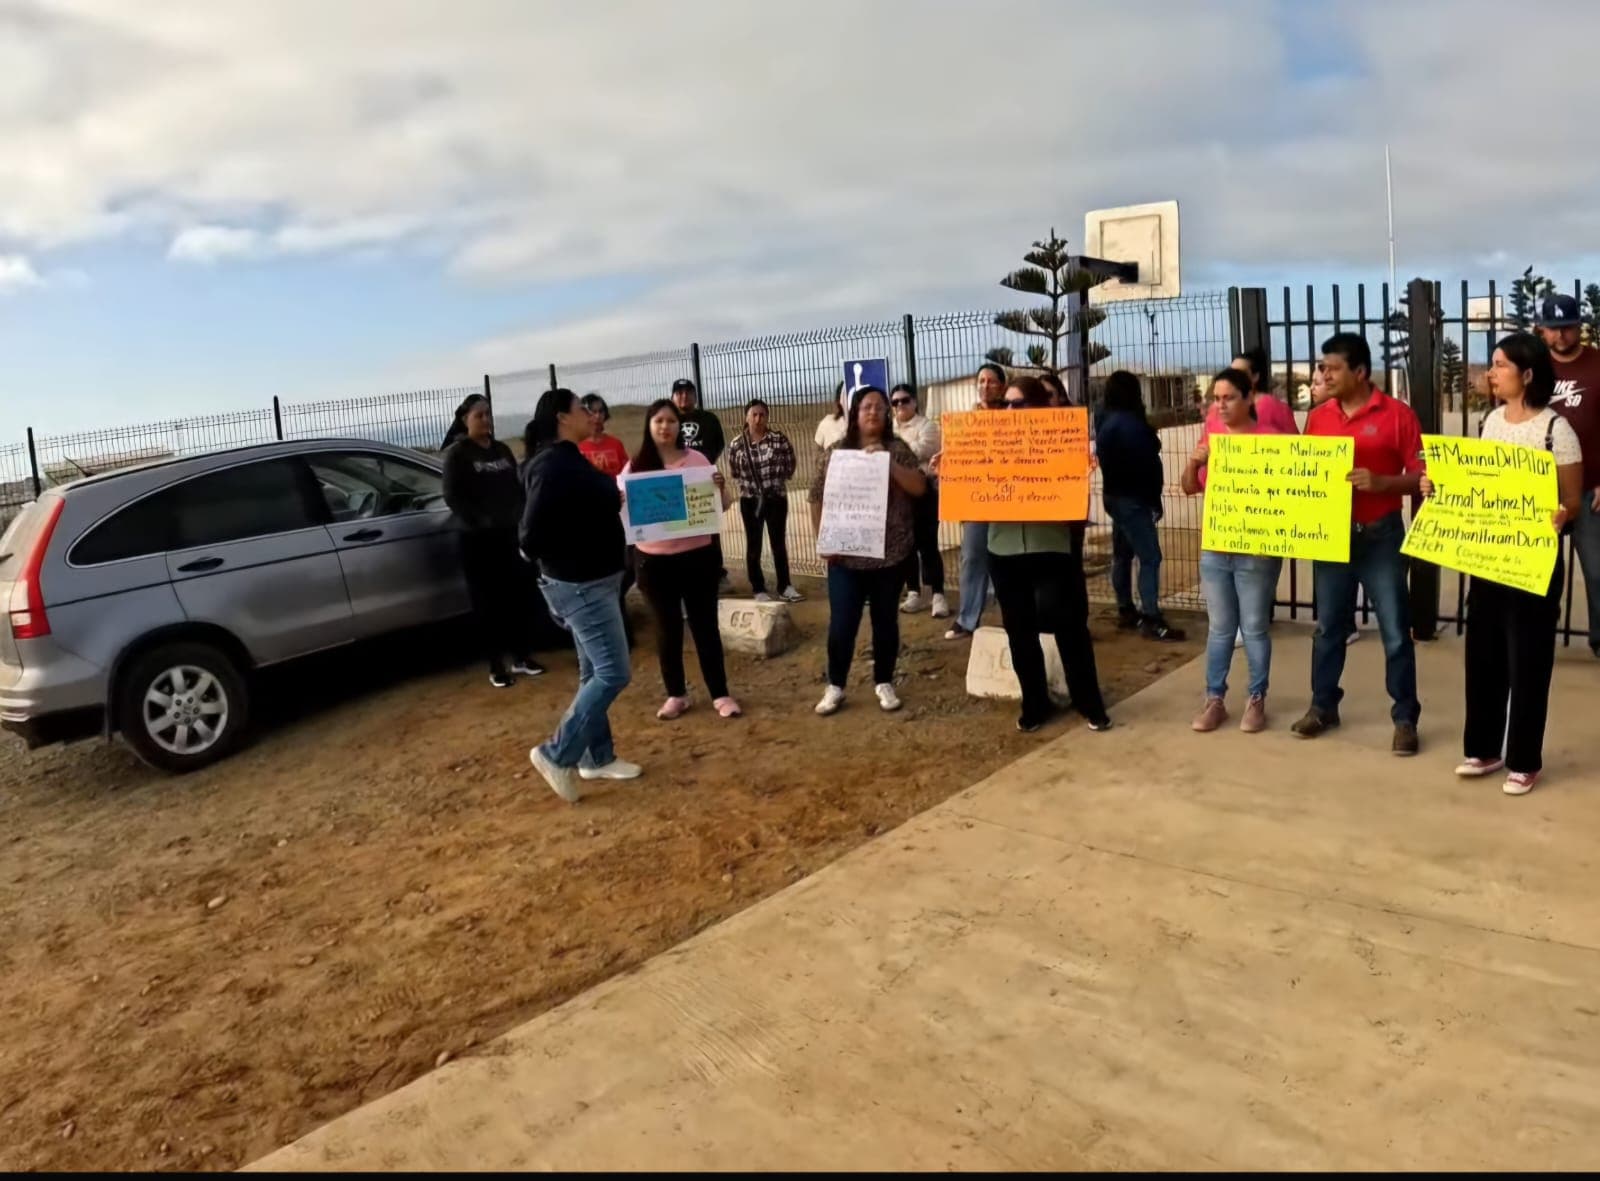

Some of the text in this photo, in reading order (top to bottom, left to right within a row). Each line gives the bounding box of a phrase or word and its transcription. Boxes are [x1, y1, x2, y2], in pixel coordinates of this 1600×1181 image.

[1250, 437, 1280, 456] Irma
[1264, 462, 1274, 476] de
[1280, 461, 1319, 477] calidad
[1266, 487, 1280, 502] que
[1211, 498, 1238, 517] hijos
[1406, 535, 1444, 553] Fitch
